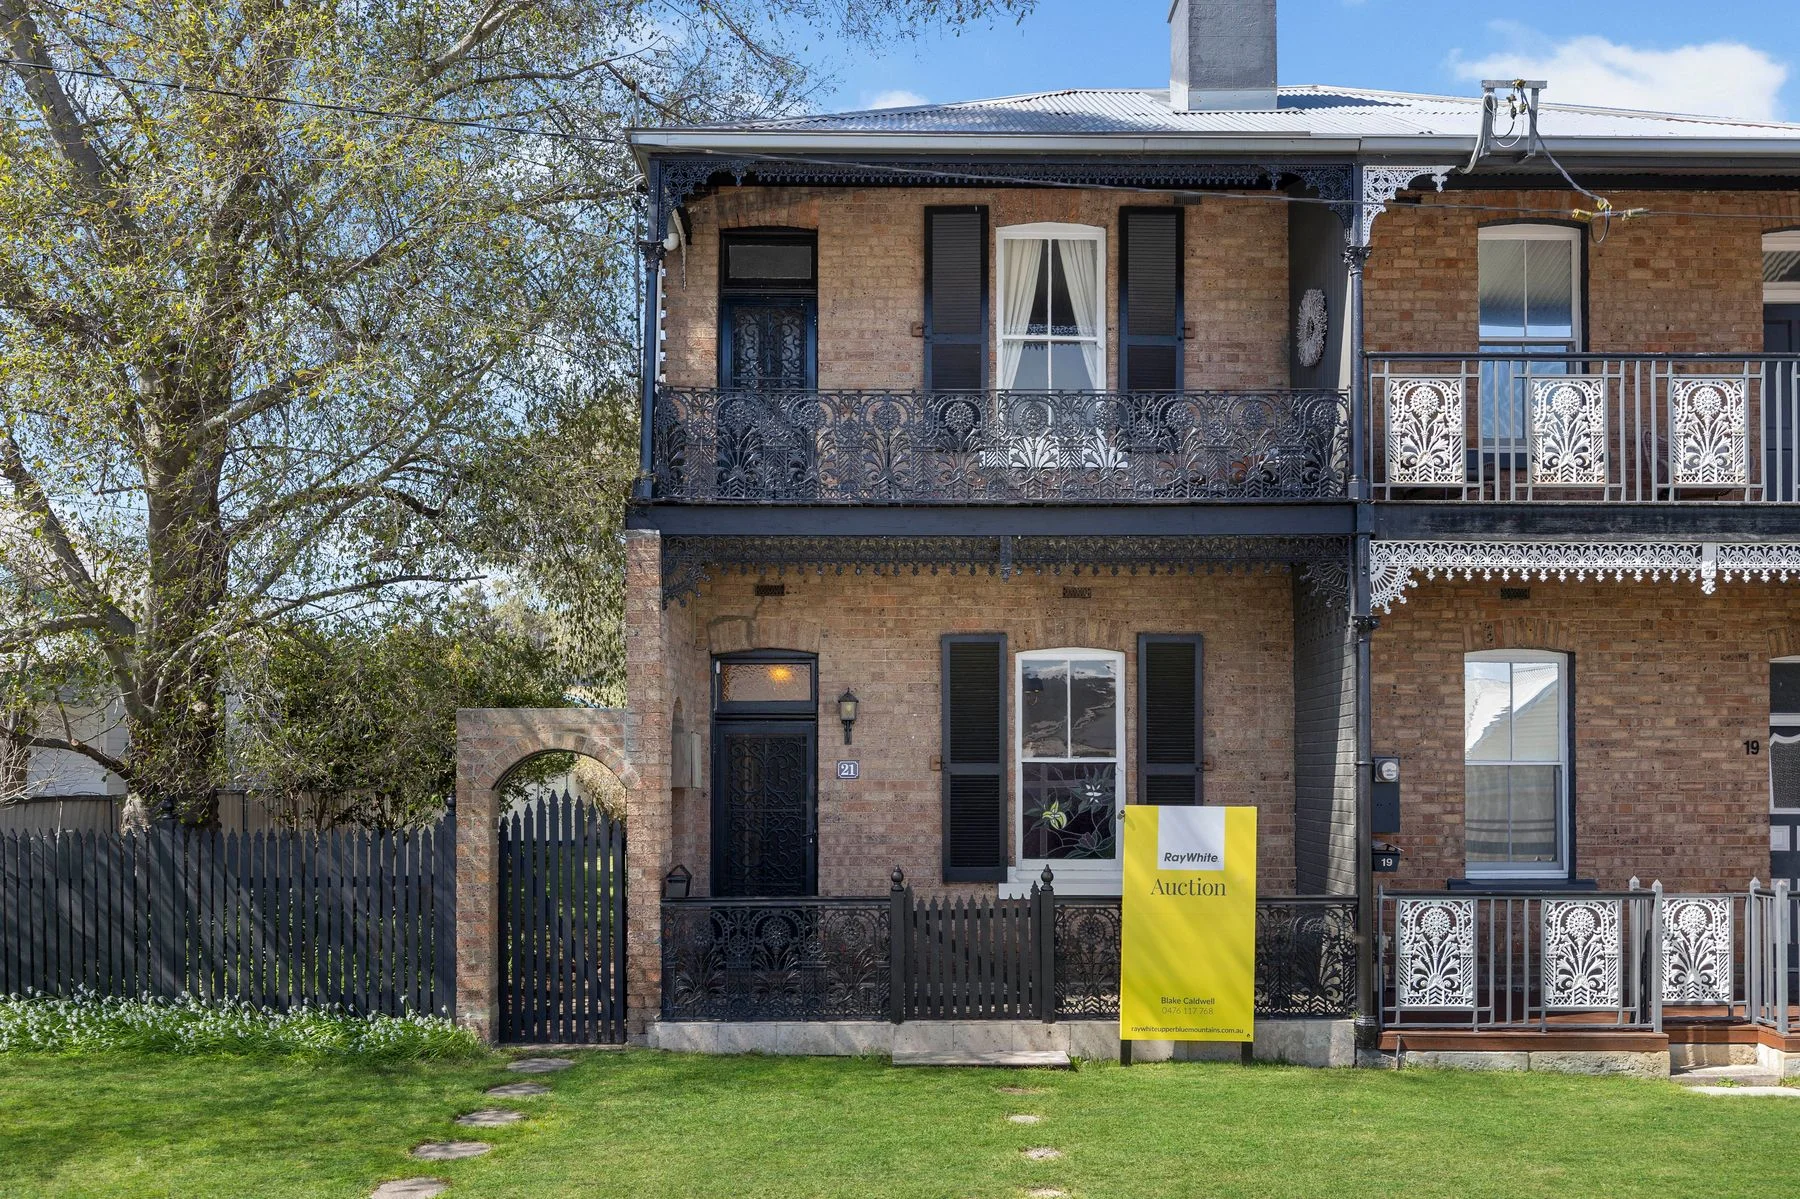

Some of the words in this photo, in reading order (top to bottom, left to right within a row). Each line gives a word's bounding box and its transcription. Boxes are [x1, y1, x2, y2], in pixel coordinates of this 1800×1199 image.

[1743, 740, 1760, 755] 19
[840, 763, 856, 775] 21
[1164, 852, 1218, 864] RayWhite
[1381, 858, 1393, 867] 19
[1150, 878, 1226, 896] Auction
[1161, 997, 1182, 1005] Blake
[1183, 997, 1215, 1005] Caldwell
[1161, 1006, 1182, 1015] 0476
[1184, 1007, 1197, 1015] 117
[1199, 1007, 1214, 1015] 768
[1131, 1026, 1244, 1034] raywhiteupperbluemountains.com.au
